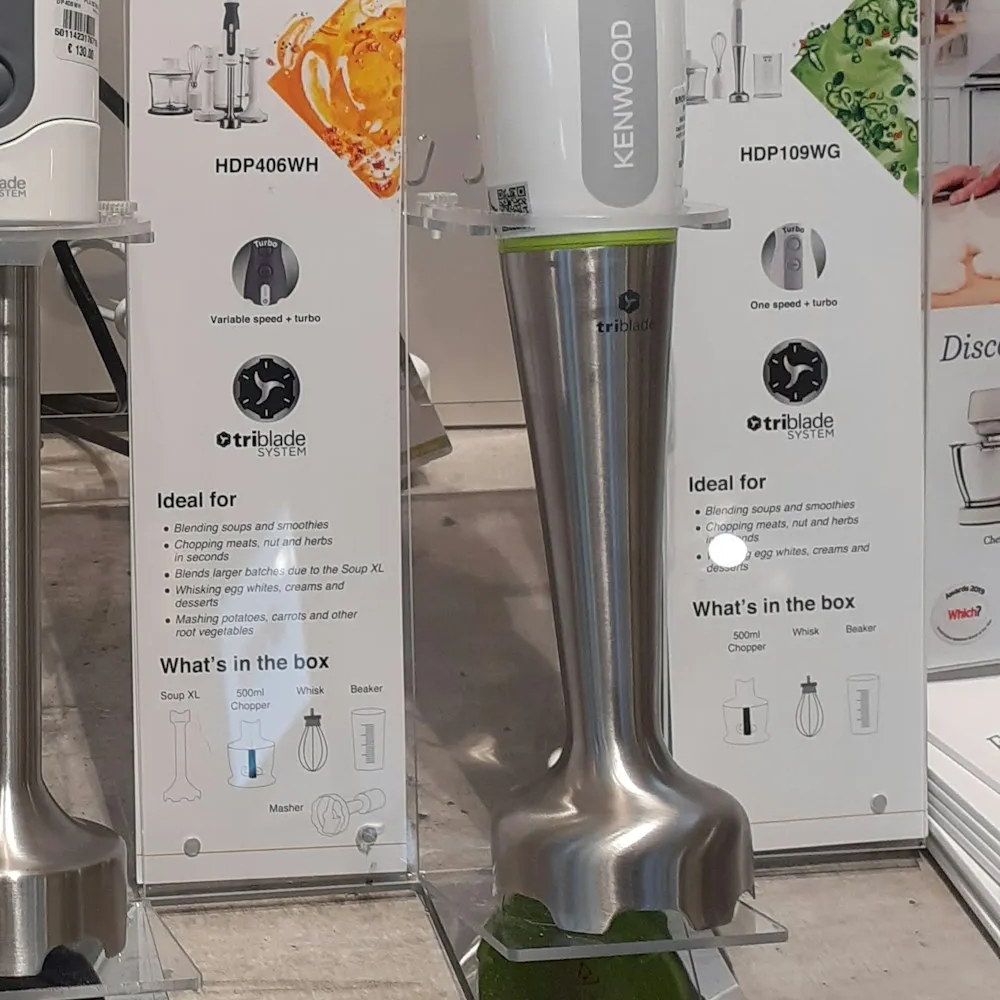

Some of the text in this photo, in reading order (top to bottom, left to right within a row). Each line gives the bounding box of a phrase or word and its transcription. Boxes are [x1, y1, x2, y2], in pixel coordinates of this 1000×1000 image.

[611, 20, 634, 168] KENWOOD
[741, 144, 840, 161] HDP109WG
[216, 158, 318, 173] HDP406WH
[253, 239, 277, 248] Turbo
[751, 299, 837, 309] One speed turbo
[211, 314, 320, 324] Variable speed turbo
[940, 333, 1000, 362] Disc
[764, 413, 833, 431] triblade
[233, 430, 306, 447] triblade
[788, 429, 834, 439] SYSTEM
[258, 447, 306, 456] SYSTEM
[689, 474, 766, 492] Ideal for
[158, 492, 236, 508] Ideal for
[705, 501, 855, 516] Blending soups and smoothies
[174, 520, 328, 534] Blending soups and smoothies
[706, 516, 859, 533] Chopping meats, nut and herbs
[174, 536, 333, 550] Chopping meats, nut and herbs
[174, 552, 229, 562] in seconds
[754, 549, 772, 560] egg
[776, 547, 809, 557] whites,
[813, 546, 848, 554] creams
[851, 544, 870, 553] and
[175, 563, 384, 579] Blends larger batches due to the Soup XL
[175, 581, 344, 596] Whisking egg whites, creams and
[175, 598, 218, 608] desserts
[763, 599, 779, 613] in
[787, 597, 815, 612] the
[822, 595, 855, 610] box
[176, 610, 357, 625] Mashing potatoes, carrots and other
[948, 605, 981, 620] Which?
[176, 626, 253, 638] root vegetables
[733, 631, 760, 640] 500ml
[792, 628, 819, 636] Whisk
[846, 624, 876, 633] Beaker
[728, 643, 766, 653] Chopper
[234, 656, 250, 671] in
[257, 655, 287, 670] the
[294, 654, 329, 669] box
[161, 690, 200, 700] Soup XL
[236, 688, 264, 697] 500ml
[297, 686, 324, 695] Whisk
[351, 684, 383, 693] Beaker
[231, 701, 270, 711] Chopper
[269, 804, 303, 813] Masher
